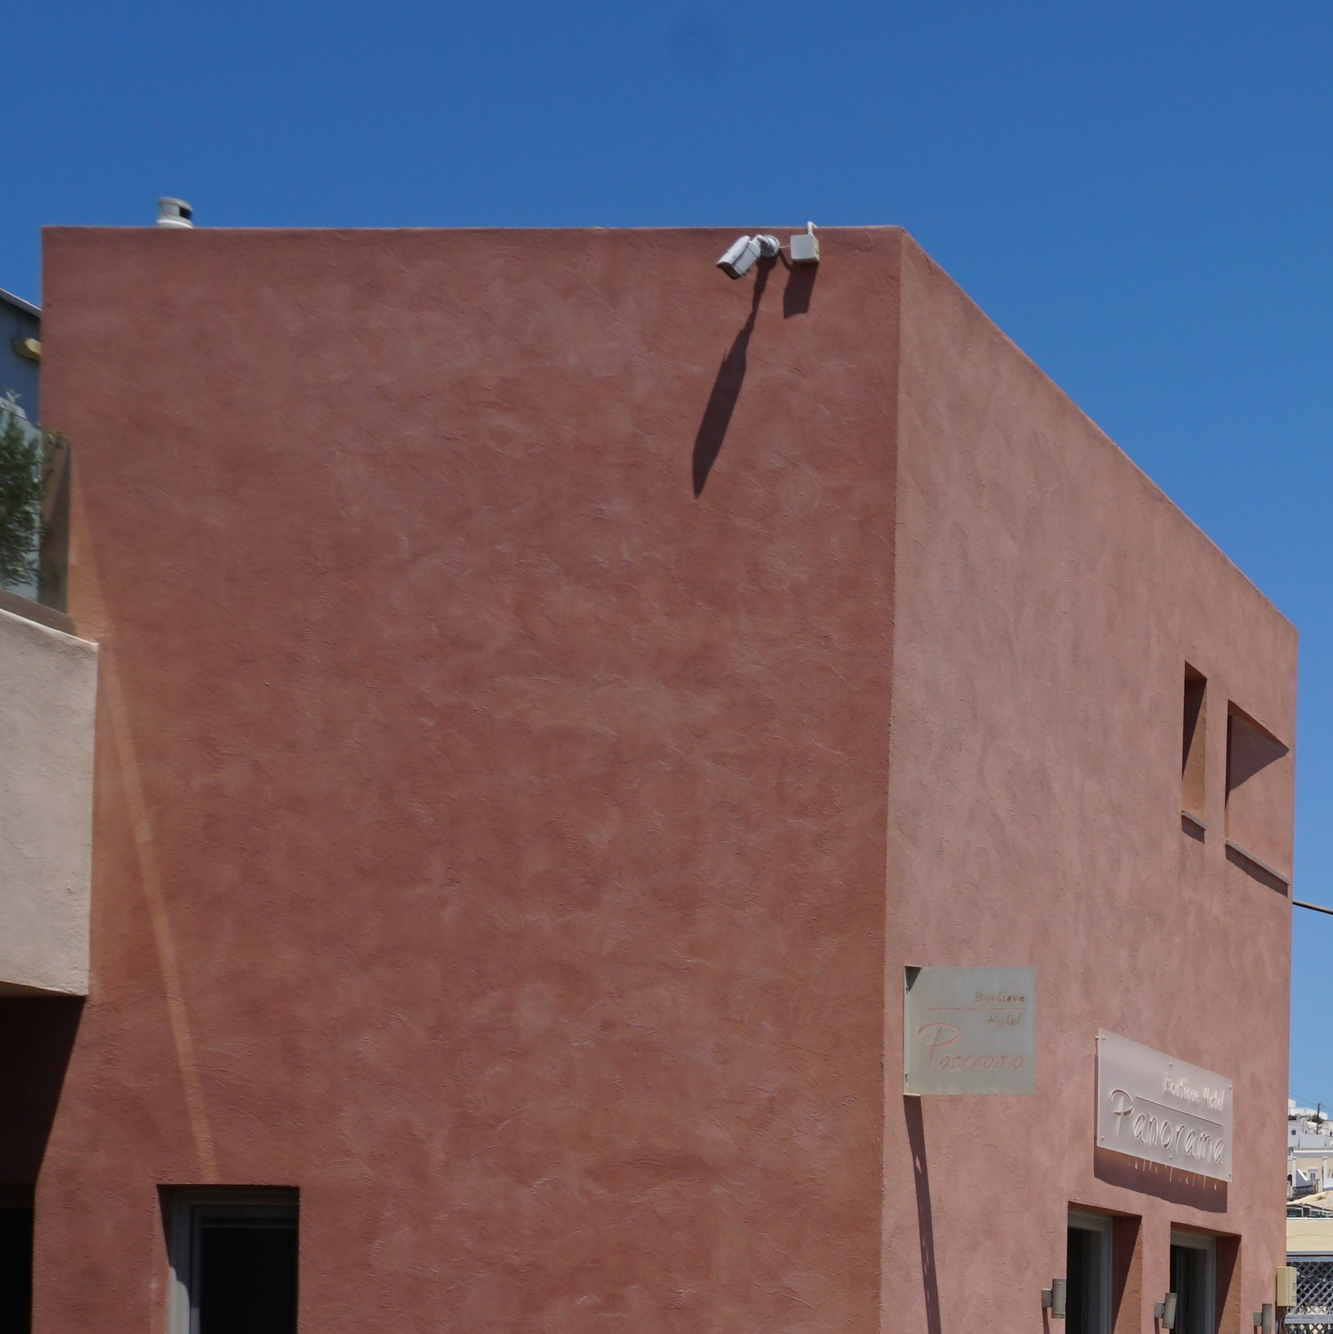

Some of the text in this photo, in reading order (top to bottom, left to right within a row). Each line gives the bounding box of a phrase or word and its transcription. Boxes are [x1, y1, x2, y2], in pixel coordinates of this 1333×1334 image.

[974, 990, 1026, 1003] Boutique
[986, 1012, 1022, 1026] Hotel
[918, 1022, 1028, 1071] Panorama
[1163, 1072, 1225, 1112] Boutique Hotel
[1110, 1088, 1225, 1165] Panorama
